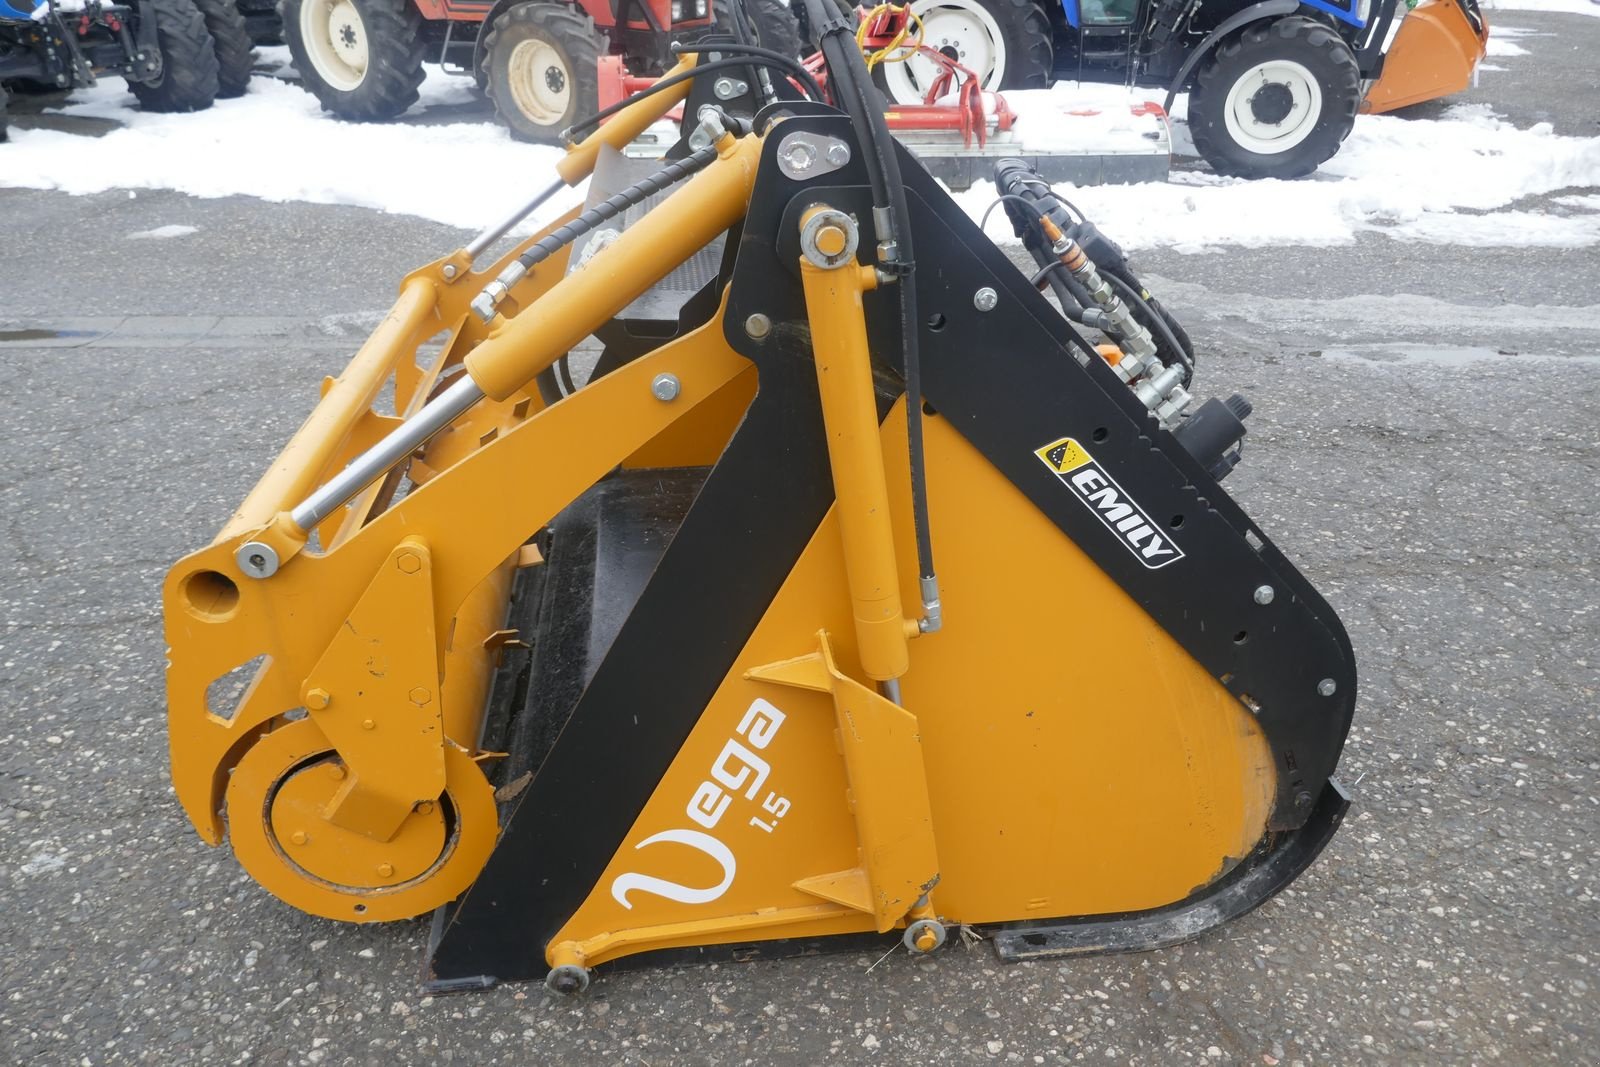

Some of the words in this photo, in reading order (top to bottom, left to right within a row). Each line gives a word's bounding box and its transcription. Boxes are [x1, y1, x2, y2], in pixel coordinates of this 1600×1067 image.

[1071, 468, 1174, 559] EMILY
[611, 698, 787, 910] Vega
[749, 791, 791, 833] 1.5
